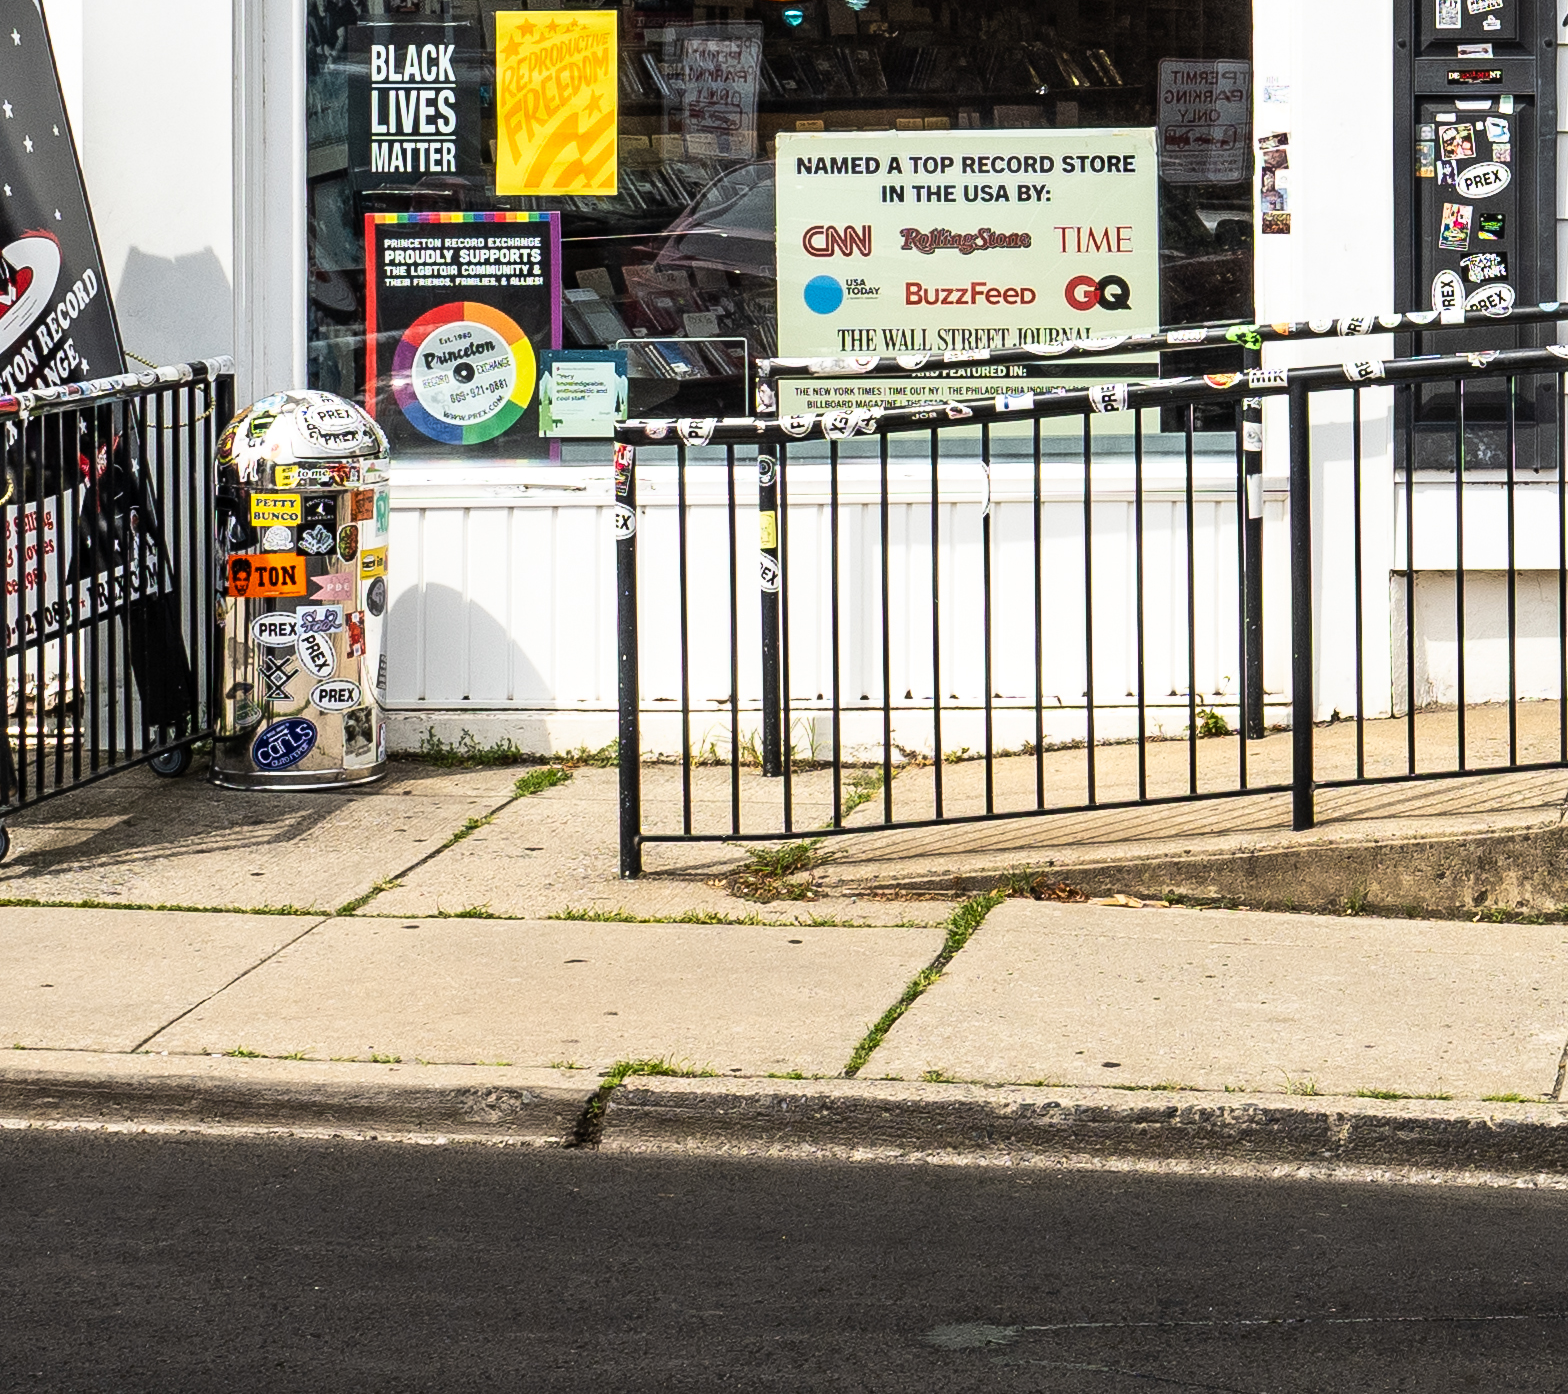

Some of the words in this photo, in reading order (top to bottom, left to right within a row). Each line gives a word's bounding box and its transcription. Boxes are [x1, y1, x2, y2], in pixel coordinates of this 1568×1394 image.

[370, 44, 456, 82] BLACK
[501, 32, 611, 110] REPRODUCTIVE
[370, 89, 457, 134] LIVES
[503, 47, 609, 166] FREEDOM
[370, 142, 457, 173] MATTER
[796, 156, 881, 175] NAMED
[887, 156, 904, 174] A
[911, 156, 955, 174] TOP
[961, 155, 1055, 174] RECORD
[1061, 154, 1136, 173] STORE
[1465, 169, 1501, 190] PREX
[881, 185, 905, 203] IN
[912, 184, 957, 203] THE
[963, 184, 1010, 203] USA
[1017, 184, 1052, 202] BY:
[384, 238, 442, 248] PRINCETON
[444, 238, 485, 248] RECORD
[487, 237, 542, 247] EXCHANGE
[802, 224, 872, 257] CNN
[1053, 225, 1134, 254] TIME
[384, 249, 454, 263] PROUDLY
[458, 249, 541, 263] SUPPORTS
[384, 265, 407, 276] THE
[461, 264, 530, 275] COMMUNITY
[532, 265, 542, 275] &
[845, 278, 867, 287] USA
[845, 286, 881, 296] TODAY
[1064, 274, 1133, 311] GQ
[36, 267, 98, 356] RECORD
[837, 328, 878, 352] THE
[882, 327, 933, 352] WALL
[937, 327, 1010, 351] STREET
[422, 340, 496, 370] Princeton
[941, 365, 1007, 377] FEATURED
[1008, 365, 1027, 377] IN:
[794, 387, 811, 396] THE
[812, 387, 832, 396] NEW
[833, 387, 855, 396] YORK
[856, 387, 883, 396] TIMES
[887, 387, 907, 396] TIME
[908, 387, 927, 396] OUT
[928, 387, 940, 396] NY
[946, 386, 964, 395] THE
[965, 386, 1028, 395] PHILADELPHIA
[807, 399, 854, 409] BILLBOARD
[317, 409, 353, 421] PREX
[255, 498, 298, 508] PETTY
[253, 511, 299, 521] BUNCO
[254, 565, 297, 587] TON
[258, 622, 298, 637] PREX
[301, 634, 330, 673] PREX
[318, 687, 355, 703] PREX
